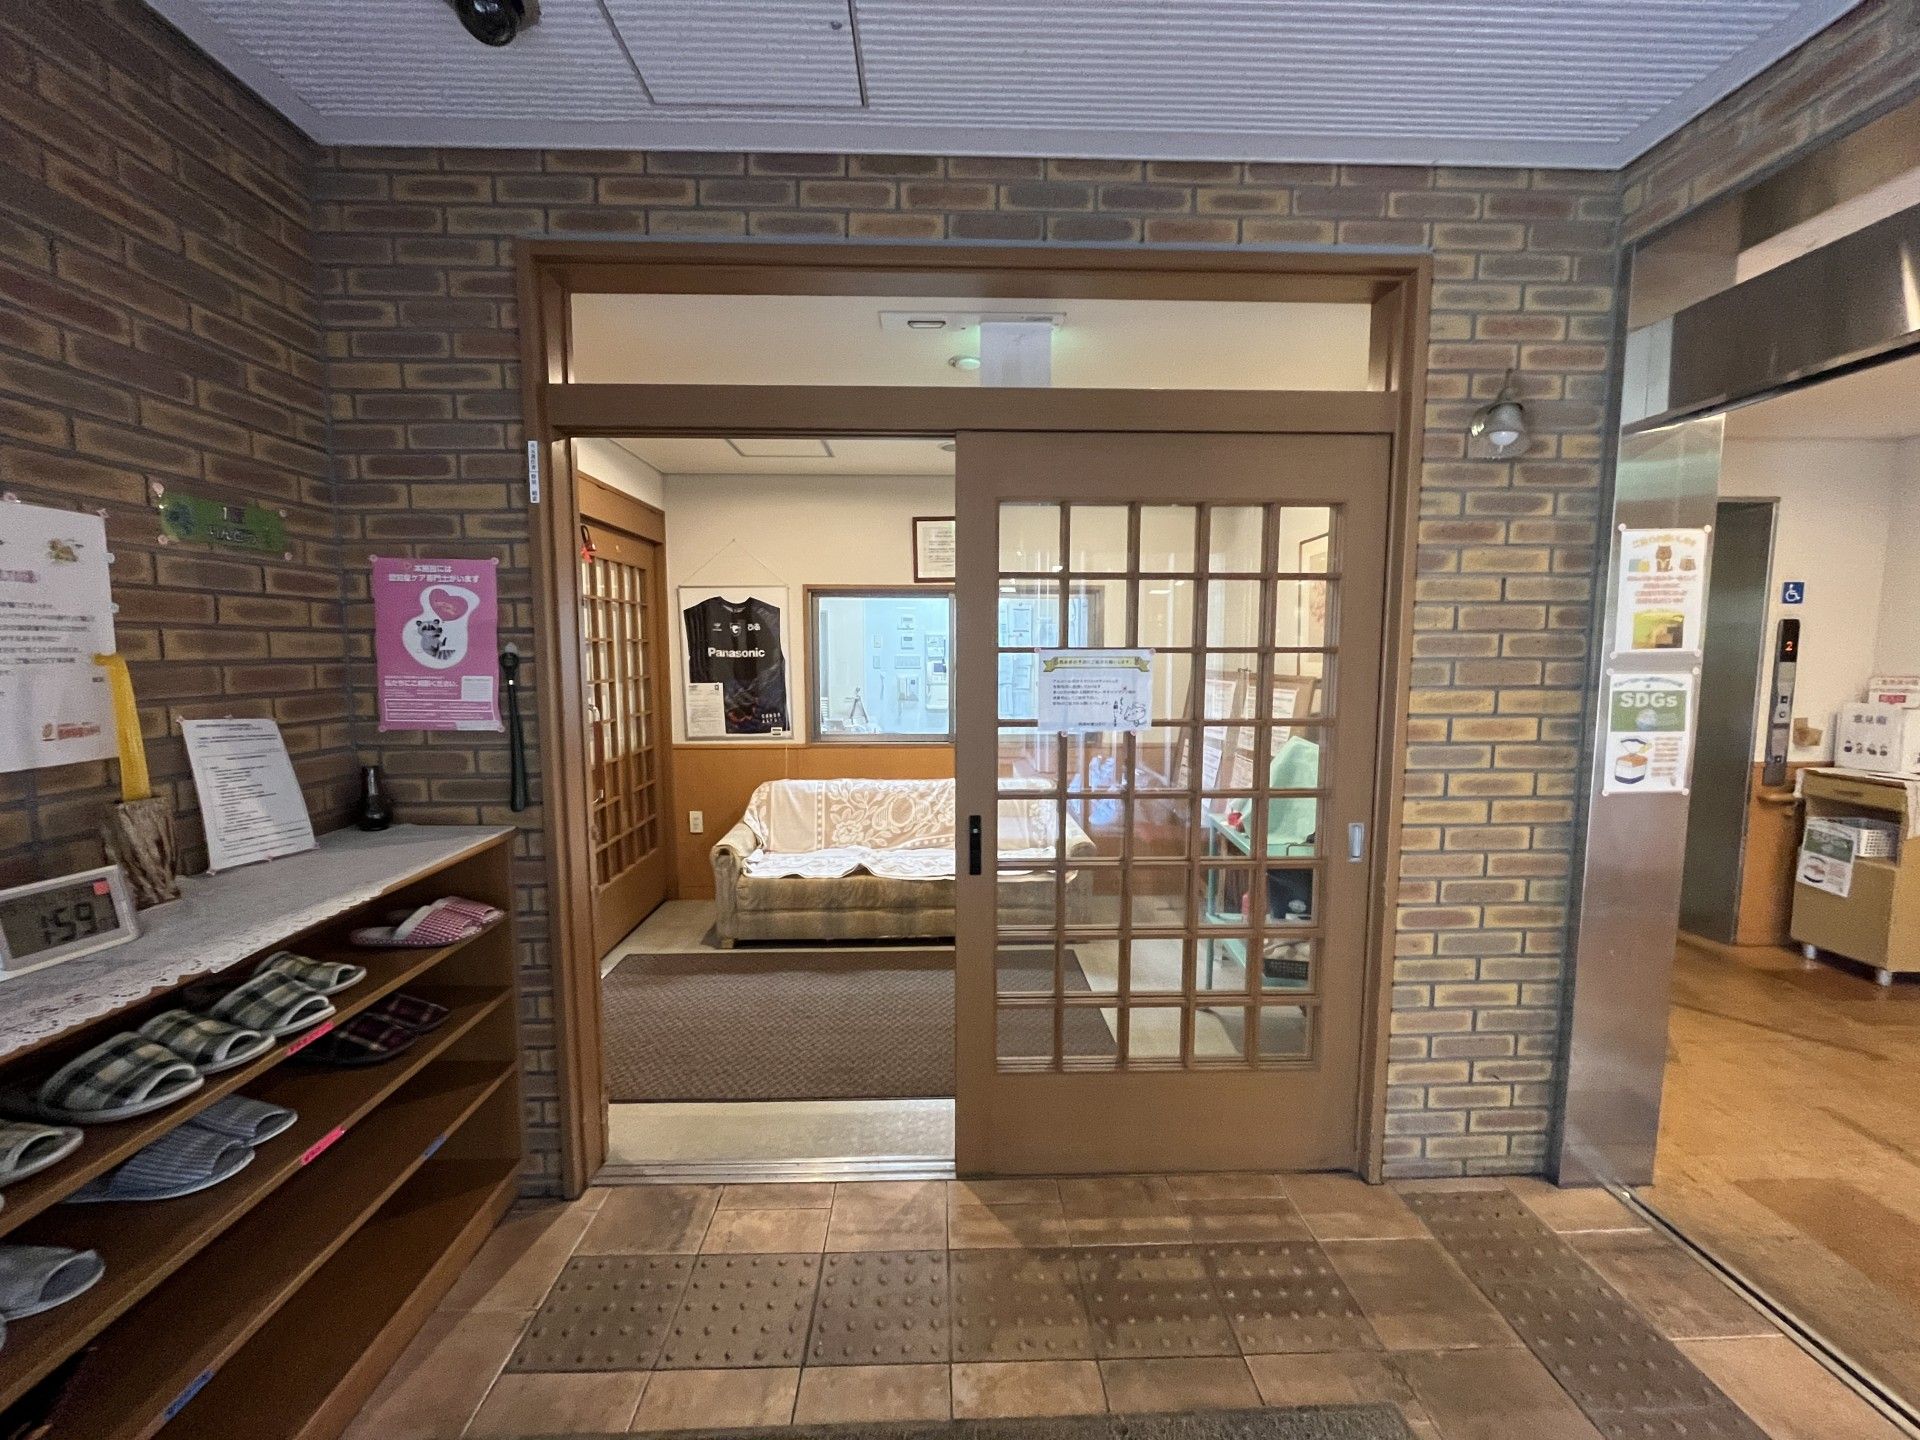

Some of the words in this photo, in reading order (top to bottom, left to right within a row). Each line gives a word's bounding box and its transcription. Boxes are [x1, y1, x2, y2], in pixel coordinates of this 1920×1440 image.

[1785, 640, 1794, 651] 2
[707, 646, 766, 658] Panasonic
[1619, 691, 1679, 708] SDGs
